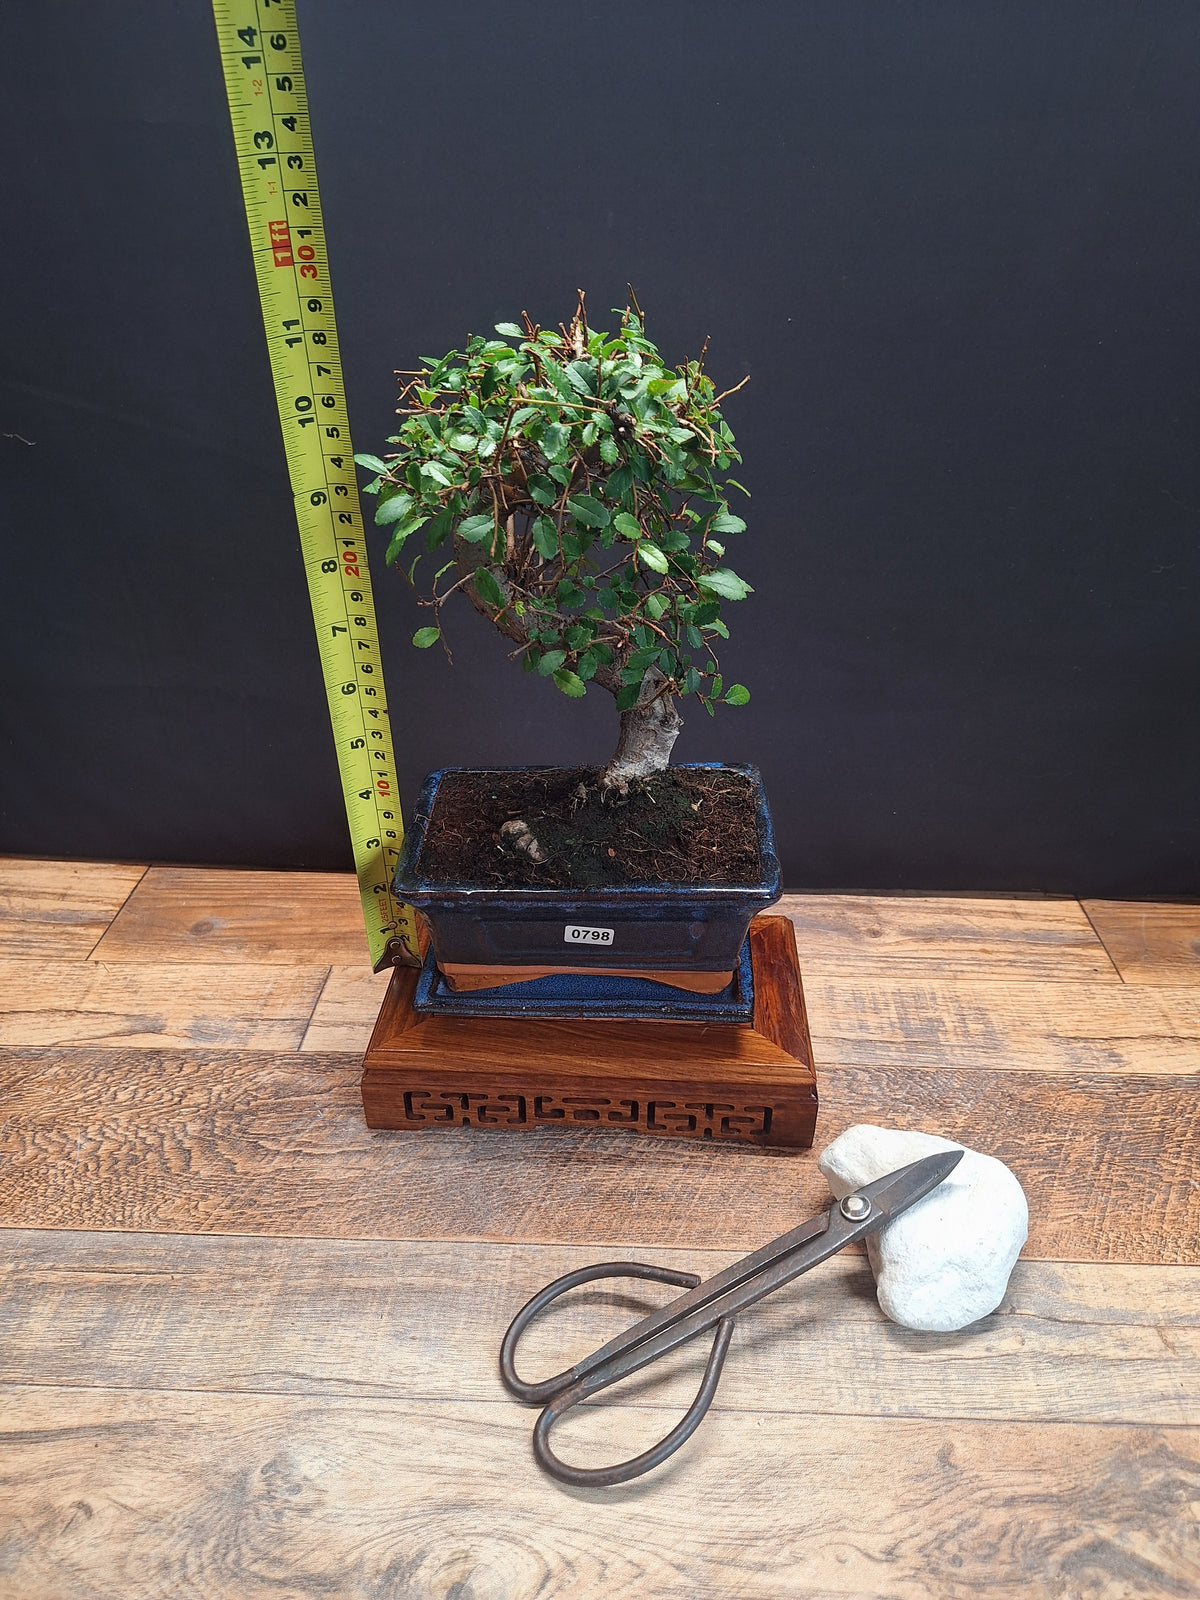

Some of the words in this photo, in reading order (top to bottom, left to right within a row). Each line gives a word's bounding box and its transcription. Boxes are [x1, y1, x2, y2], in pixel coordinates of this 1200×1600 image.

[237, 26, 262, 70] 14
[270, 33, 287, 51] 6
[276, 76, 293, 92] 5
[282, 116, 298, 132] 4
[254, 131, 276, 170] 13
[287, 155, 303, 169] 3
[292, 192, 309, 207] 2
[297, 229, 312, 239] 1
[297, 245, 318, 279] 30
[307, 298, 322, 313] 9
[282, 319, 303, 348] 11
[312, 332, 327, 345] 8
[316, 364, 331, 377] 7
[321, 396, 336, 409] 6
[294, 395, 315, 429] 10
[326, 426, 340, 439] 5
[330, 456, 344, 469] 4
[335, 485, 348, 497] 3
[310, 491, 327, 507] 9
[338, 513, 352, 525] 2
[342, 540, 355, 548] 1
[321, 559, 338, 574] 8
[342, 551, 360, 578] 20
[350, 592, 364, 602] 9
[354, 616, 367, 627] 8
[332, 625, 347, 637] 7
[358, 641, 370, 651] 7
[361, 664, 374, 674] 6
[341, 682, 357, 696] 6
[365, 687, 377, 697] 5
[368, 709, 379, 719] 4
[371, 731, 383, 740] 3
[350, 738, 365, 750] 5
[374, 751, 386, 760] 2
[359, 789, 372, 801] 4
[376, 780, 390, 797] 10
[383, 811, 394, 820] 9
[385, 830, 396, 839] 8
[366, 838, 381, 849] 3
[373, 883, 387, 894] 2
[571, 929, 610, 941] 0798
